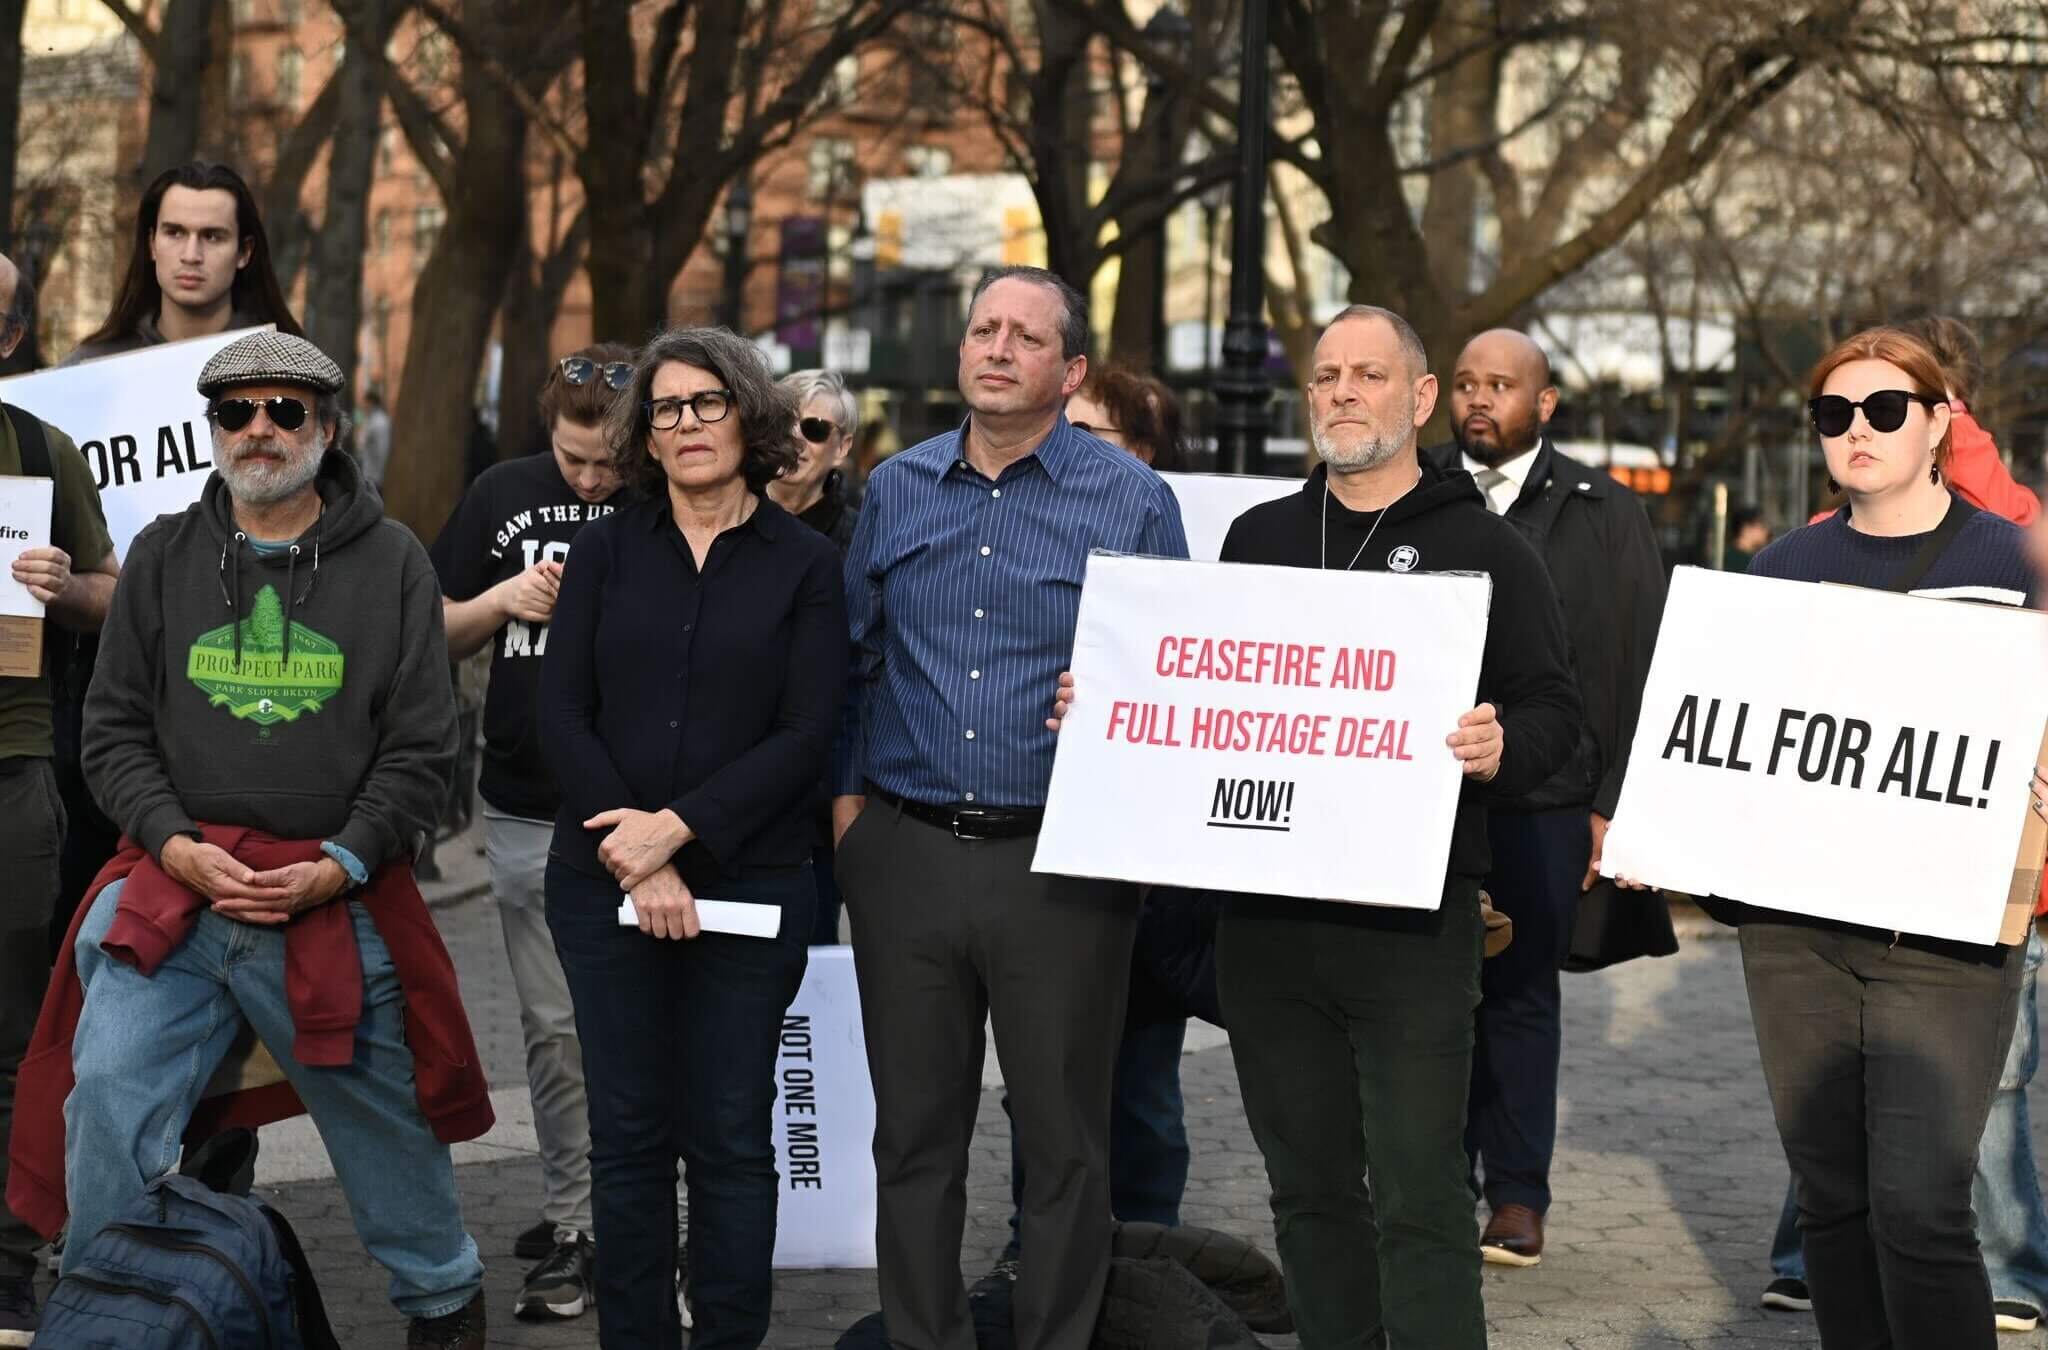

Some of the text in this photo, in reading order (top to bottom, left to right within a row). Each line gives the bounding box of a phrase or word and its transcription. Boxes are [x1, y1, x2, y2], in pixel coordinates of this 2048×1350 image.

[0, 526, 29, 541] fire
[496, 510, 533, 548] SAW
[538, 504, 581, 523] THE
[195, 653, 338, 680] PROSPECT PARK
[1155, 636, 1397, 691] CEASEFIRE AND
[215, 683, 318, 697] PARK SLOPE BKLYN
[1106, 701, 1413, 760] FULL HOSTAGE DEAL
[1661, 694, 2001, 809] ALL FOR ALL!
[1210, 778, 1295, 823] NOW!
[781, 1015, 822, 1190] NOT ONE MORE
